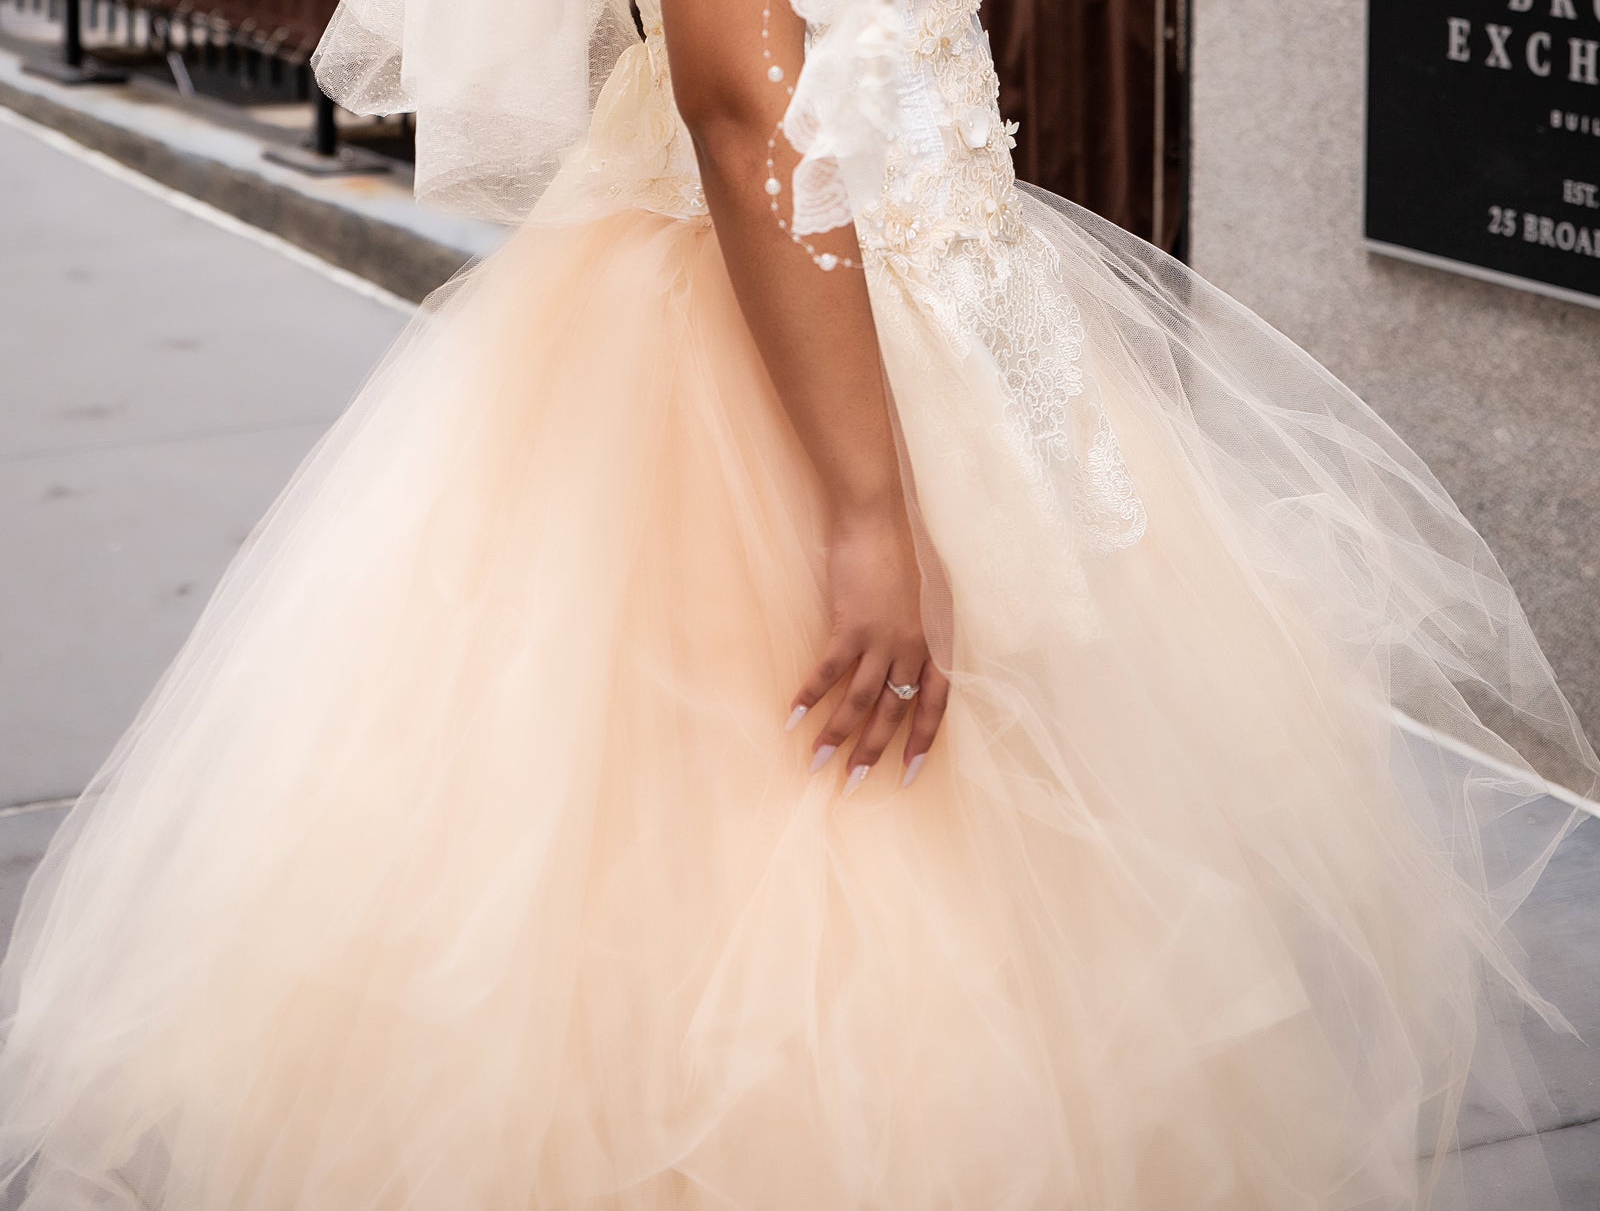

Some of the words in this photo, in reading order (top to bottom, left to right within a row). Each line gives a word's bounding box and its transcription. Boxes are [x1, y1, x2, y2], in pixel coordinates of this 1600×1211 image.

[1447, 16, 1600, 85] EXCH
[1562, 178, 1600, 210] EST.
[1487, 204, 1518, 238] 25
